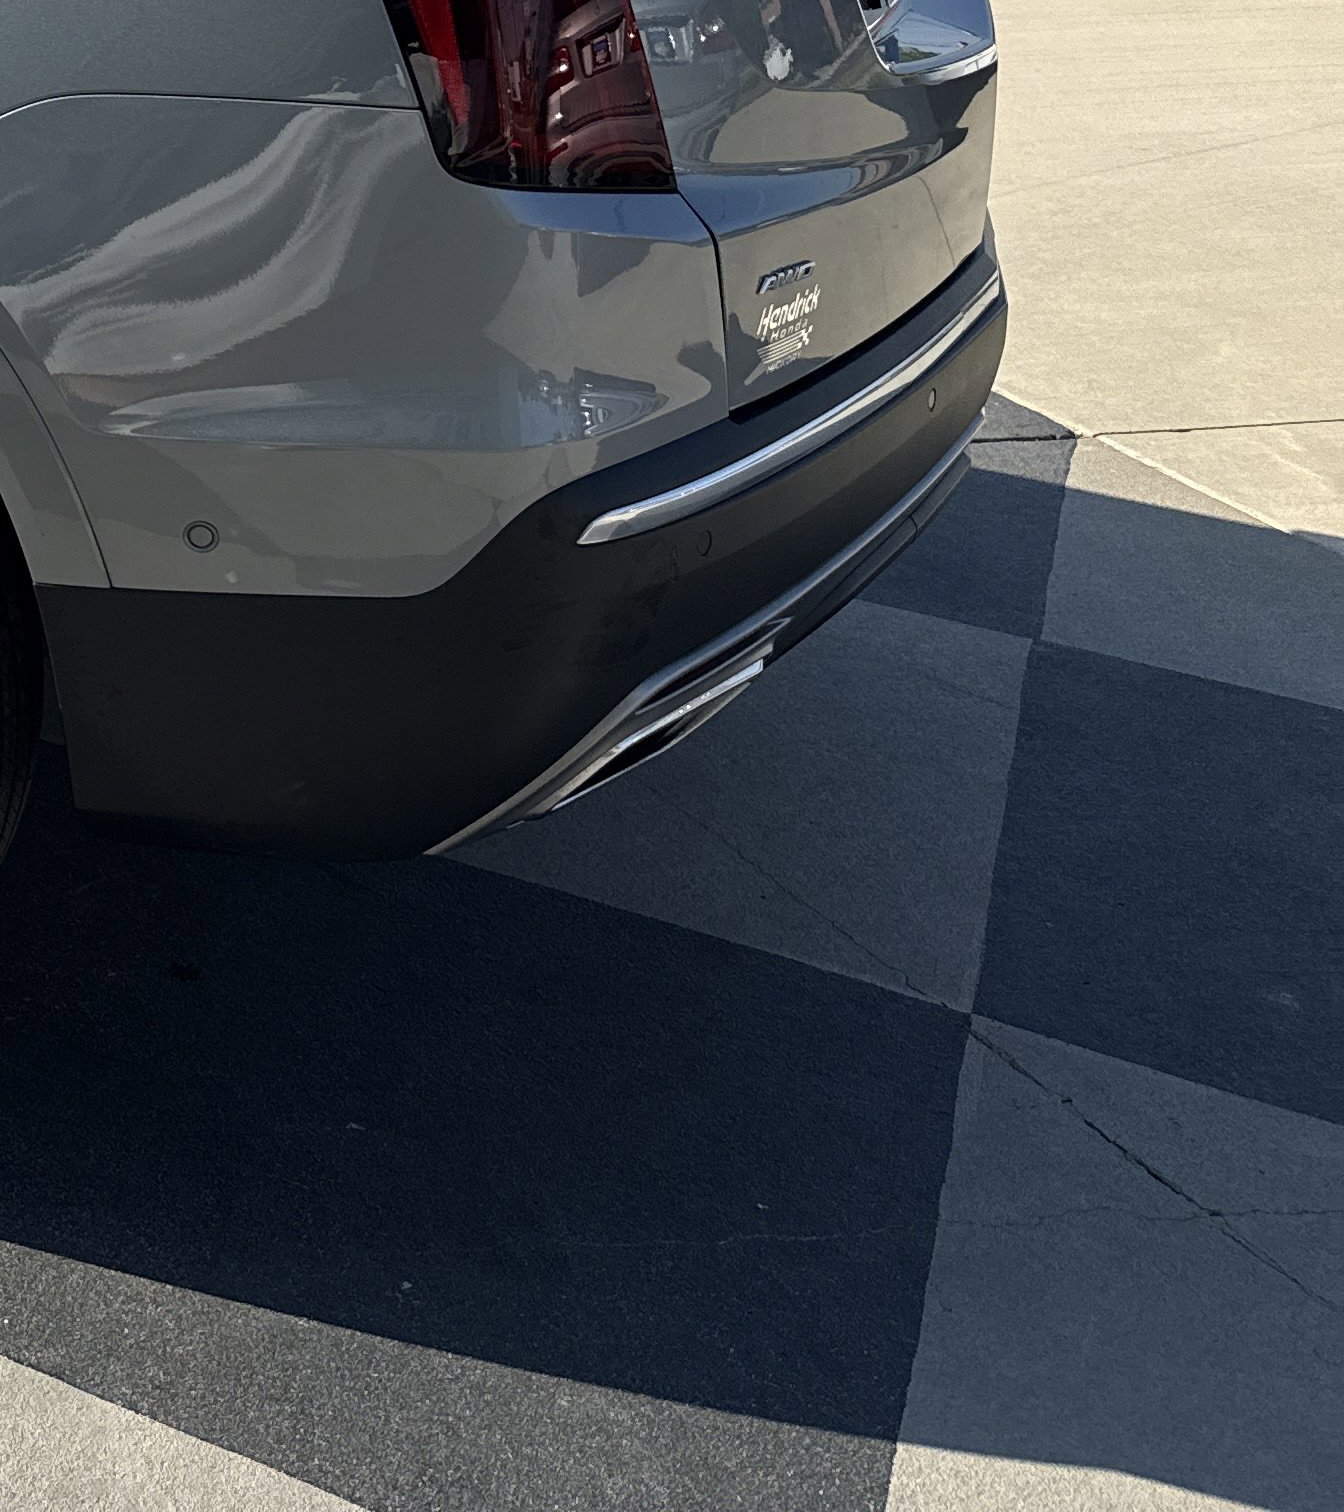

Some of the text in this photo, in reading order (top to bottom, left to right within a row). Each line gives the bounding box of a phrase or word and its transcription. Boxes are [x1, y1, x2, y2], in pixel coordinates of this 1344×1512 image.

[755, 259, 816, 295] AWD
[756, 283, 821, 342] Hendrick
[770, 318, 809, 343] Honda
